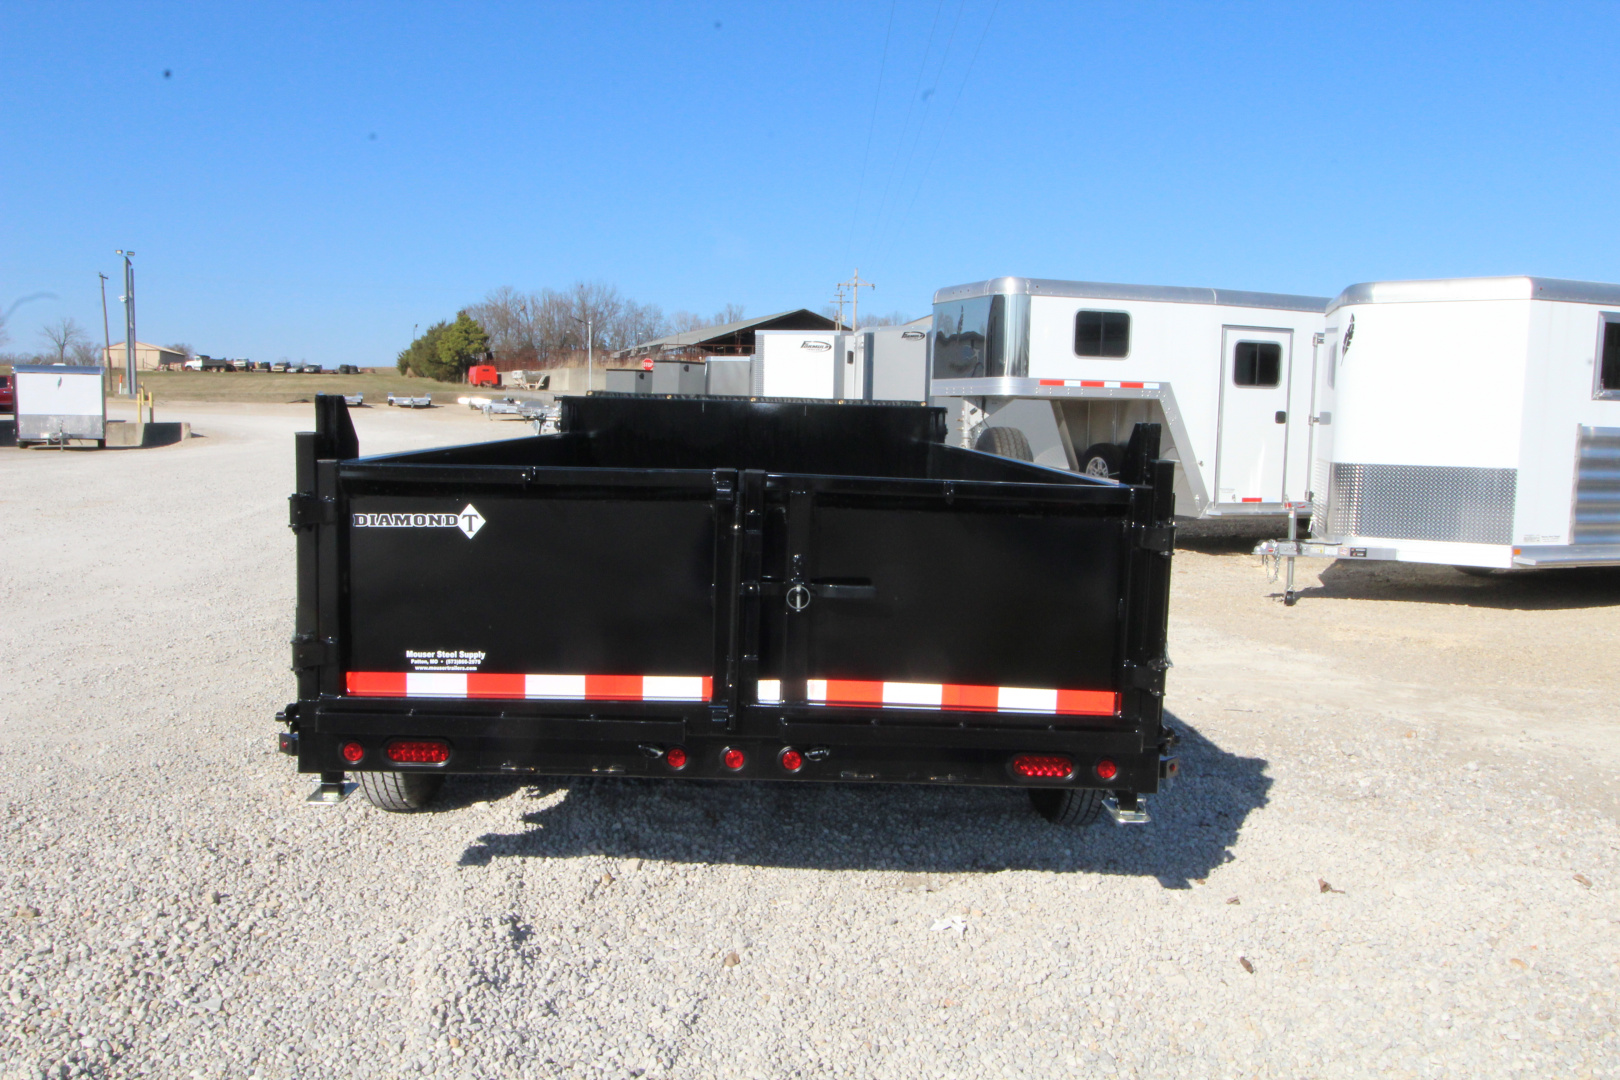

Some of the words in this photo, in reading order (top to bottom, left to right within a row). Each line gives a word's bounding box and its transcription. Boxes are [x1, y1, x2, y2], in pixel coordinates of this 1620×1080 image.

[353, 513, 459, 527] DIAMOND
[461, 514, 479, 532] T
[406, 650, 435, 658] Mouser
[436, 650, 457, 659] Steel
[459, 650, 486, 660] Supply
